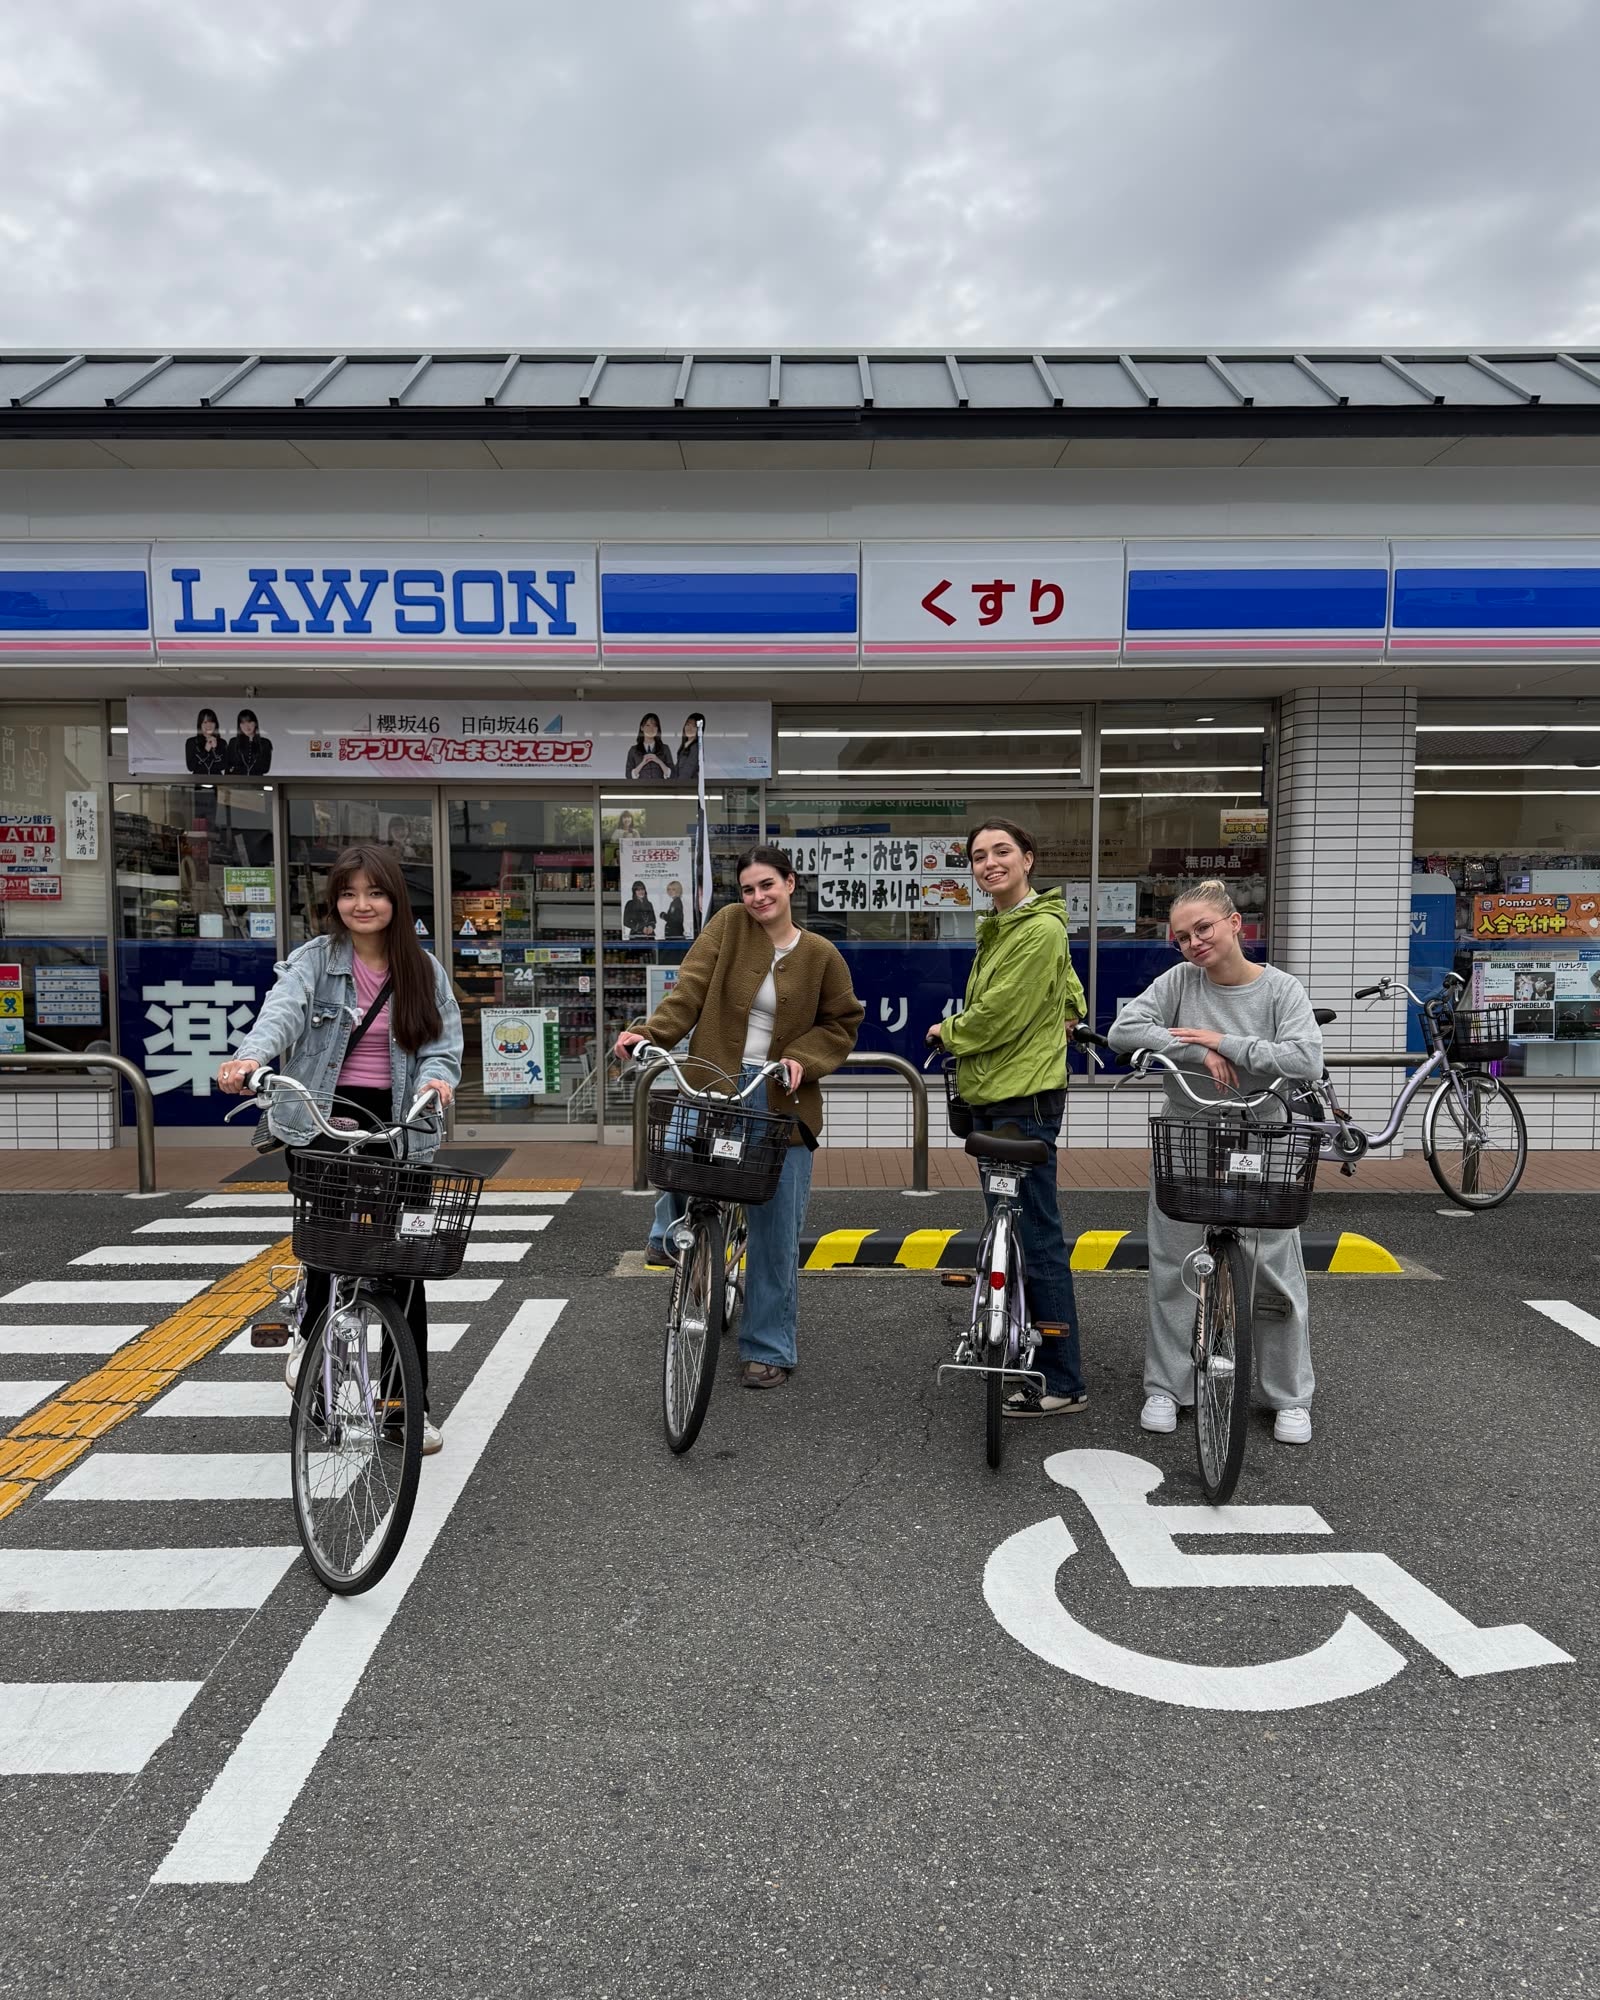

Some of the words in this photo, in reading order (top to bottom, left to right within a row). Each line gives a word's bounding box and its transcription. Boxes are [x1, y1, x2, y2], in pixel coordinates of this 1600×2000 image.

[172, 568, 577, 635] LAWSON
[921, 578, 1065, 626] くすり
[377, 714, 440, 734] 櫻坂46
[462, 715, 539, 735] 日向坂46
[445, 740, 593, 763] たまるよスタンプ
[7, 829, 47, 841] ATM
[817, 825, 872, 836] くすりコーナー
[1185, 856, 1241, 869] 無印良品
[8, 880, 28, 888] ATM
[820, 879, 920, 910] ご予約承り中
[1497, 897, 1552, 908] Pontaパス
[1477, 912, 1567, 935] 入会受付中
[514, 968, 533, 981] 24
[142, 980, 256, 1096] 薬
